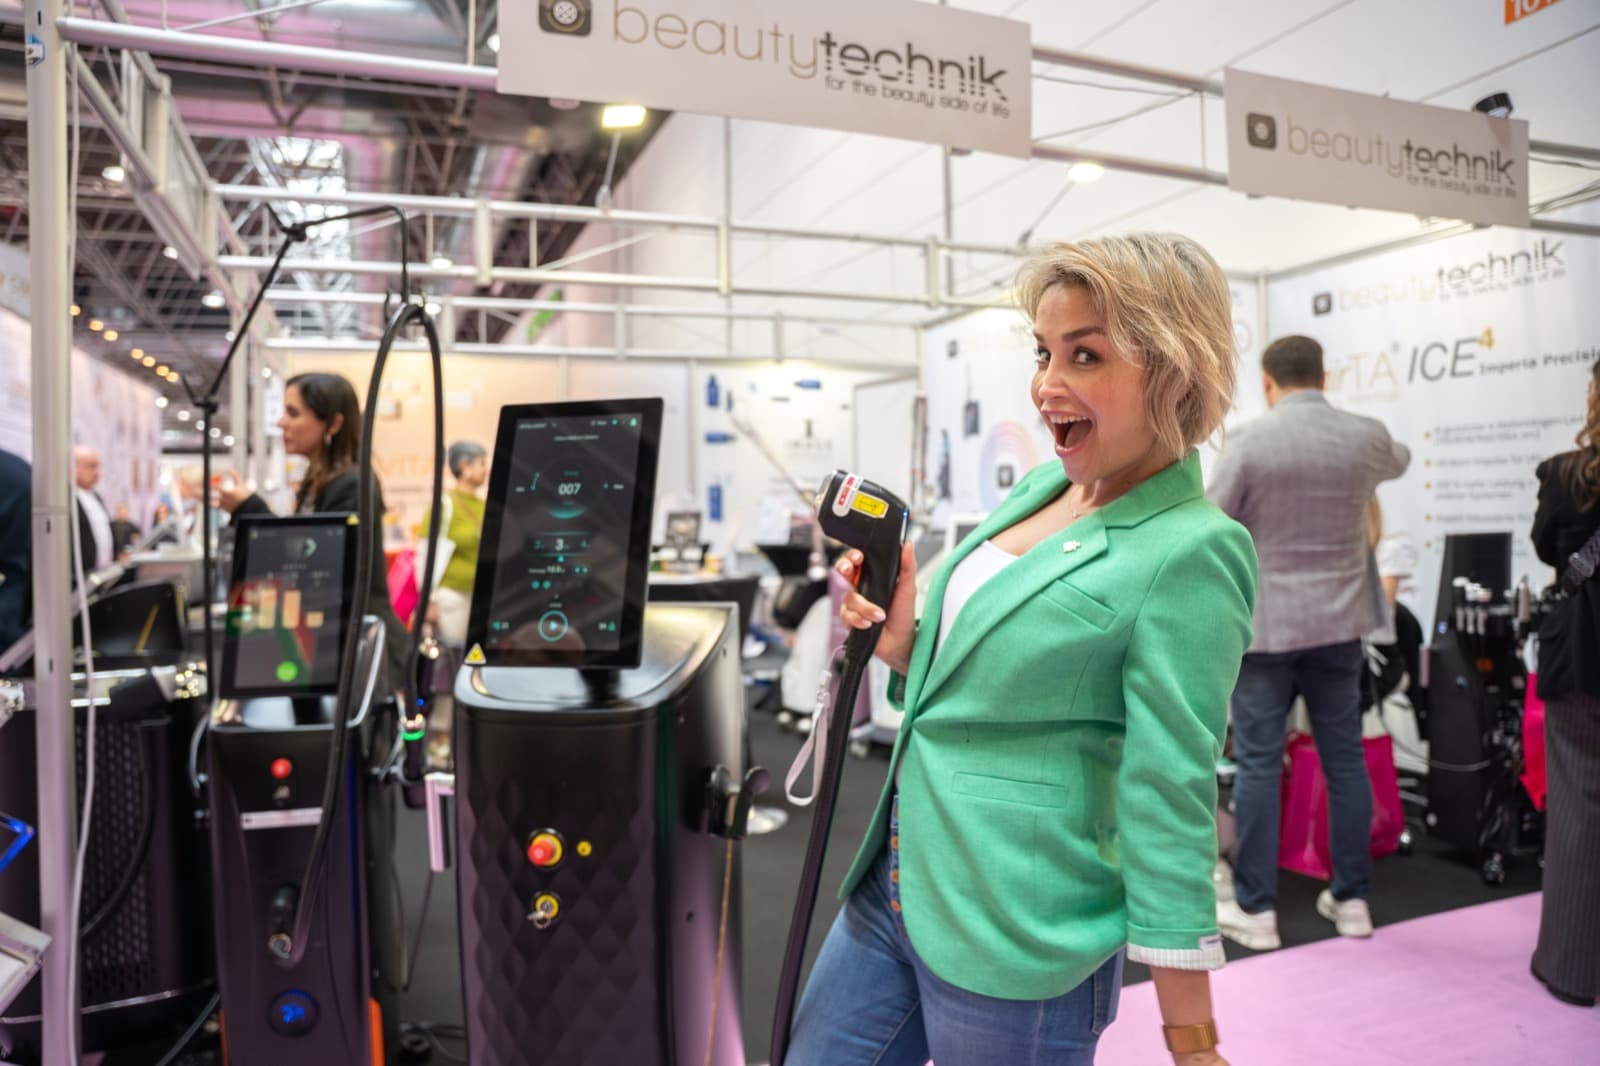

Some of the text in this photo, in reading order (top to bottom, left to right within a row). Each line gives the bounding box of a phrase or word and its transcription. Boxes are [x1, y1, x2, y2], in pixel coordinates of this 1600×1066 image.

[612, 0, 1008, 100] beautytechnik
[825, 75, 845, 91] for
[852, 79, 877, 97] the
[882, 84, 936, 109] beauty
[1286, 115, 1516, 186] beautytechnik
[558, 482, 582, 496] 007
